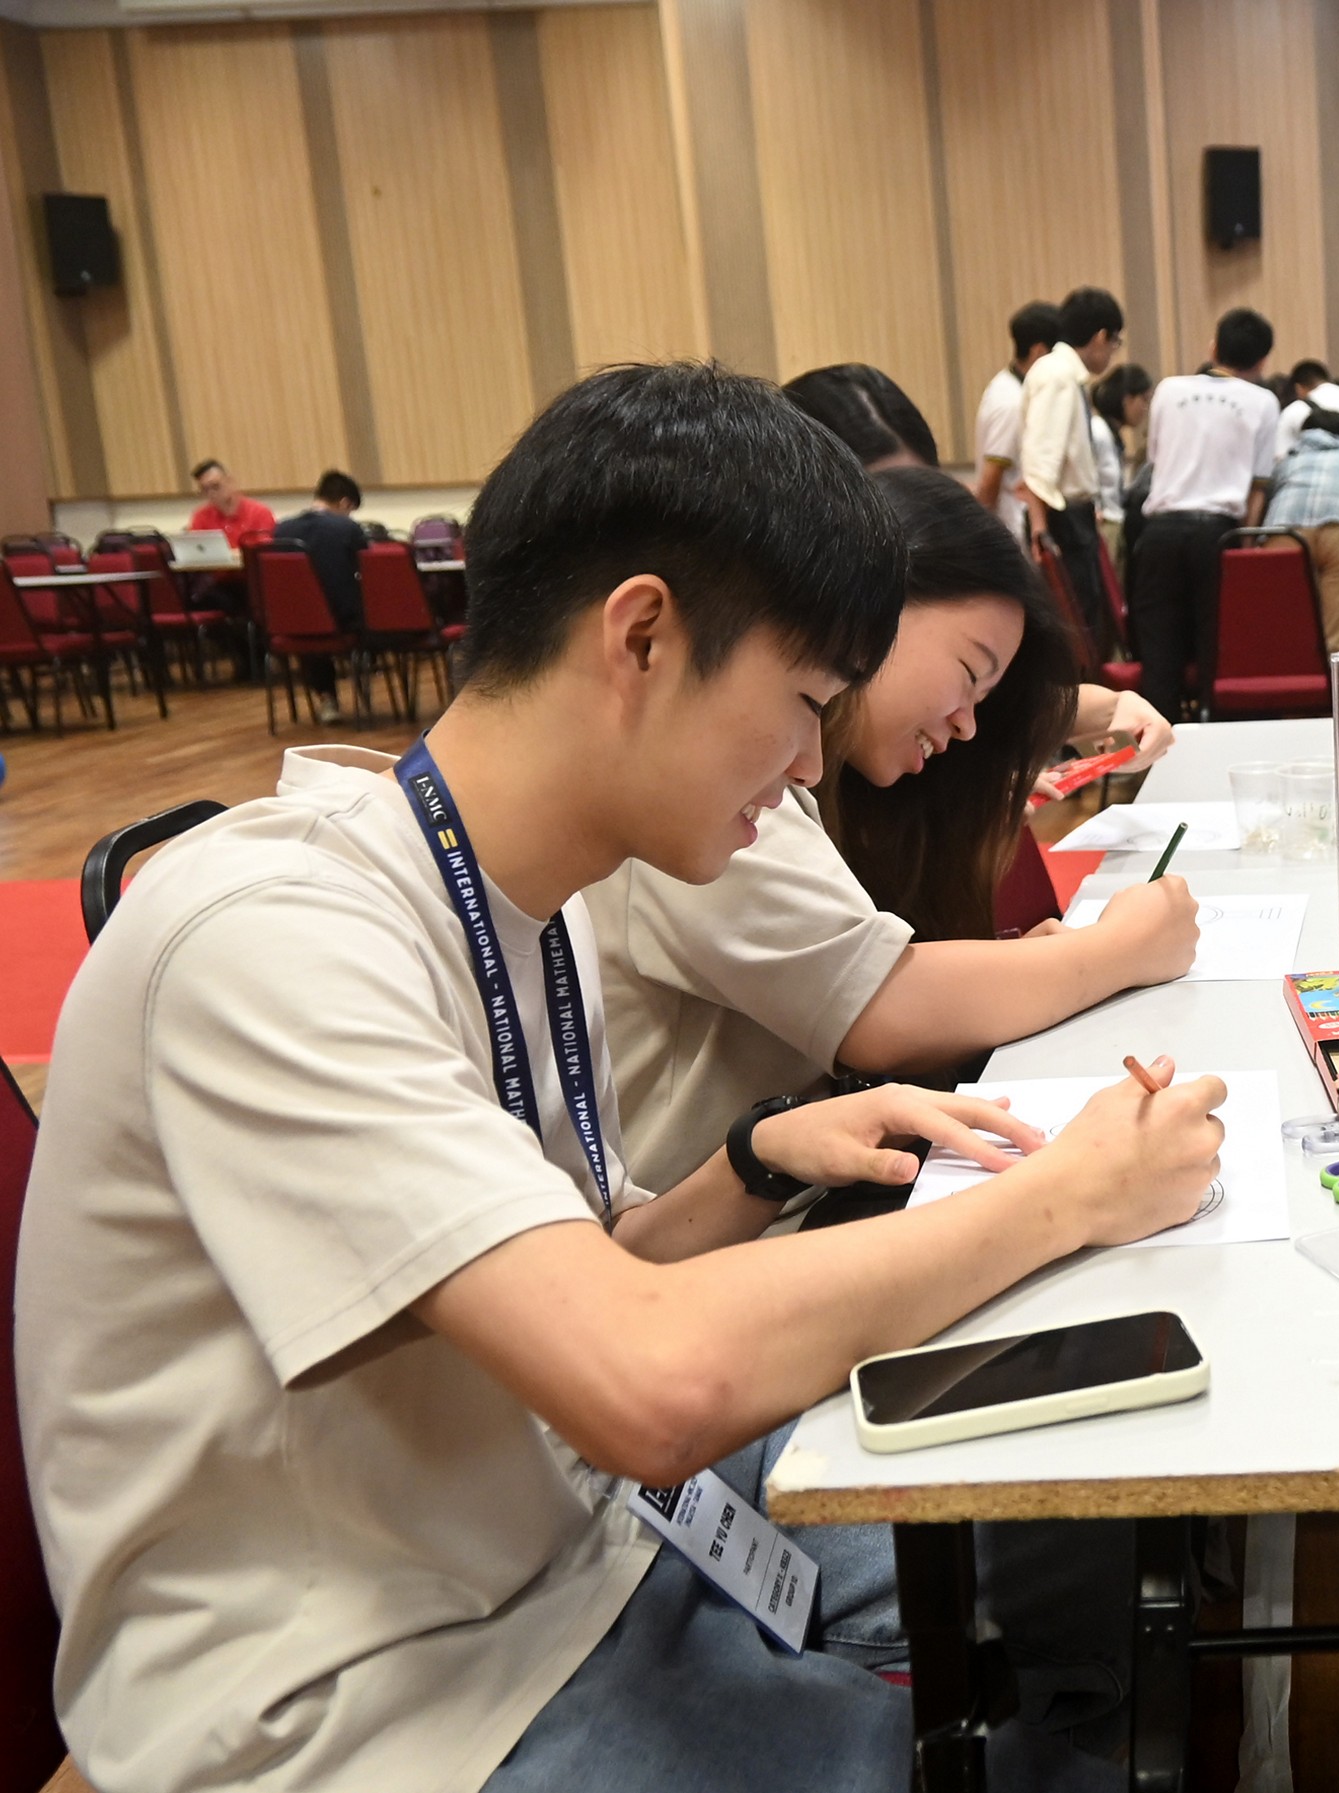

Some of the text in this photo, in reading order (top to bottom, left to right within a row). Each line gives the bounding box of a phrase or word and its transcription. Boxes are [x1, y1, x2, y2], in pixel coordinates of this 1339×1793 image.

[416, 775, 447, 822] I-NMC
[447, 850, 498, 978] INTERNATIONAL
[491, 995, 517, 1074] NATIONAL
[547, 920, 570, 998] MATHEMA
[558, 1002, 580, 1076] NATIONAL
[709, 1502, 736, 1562] TEE YU CHEN
